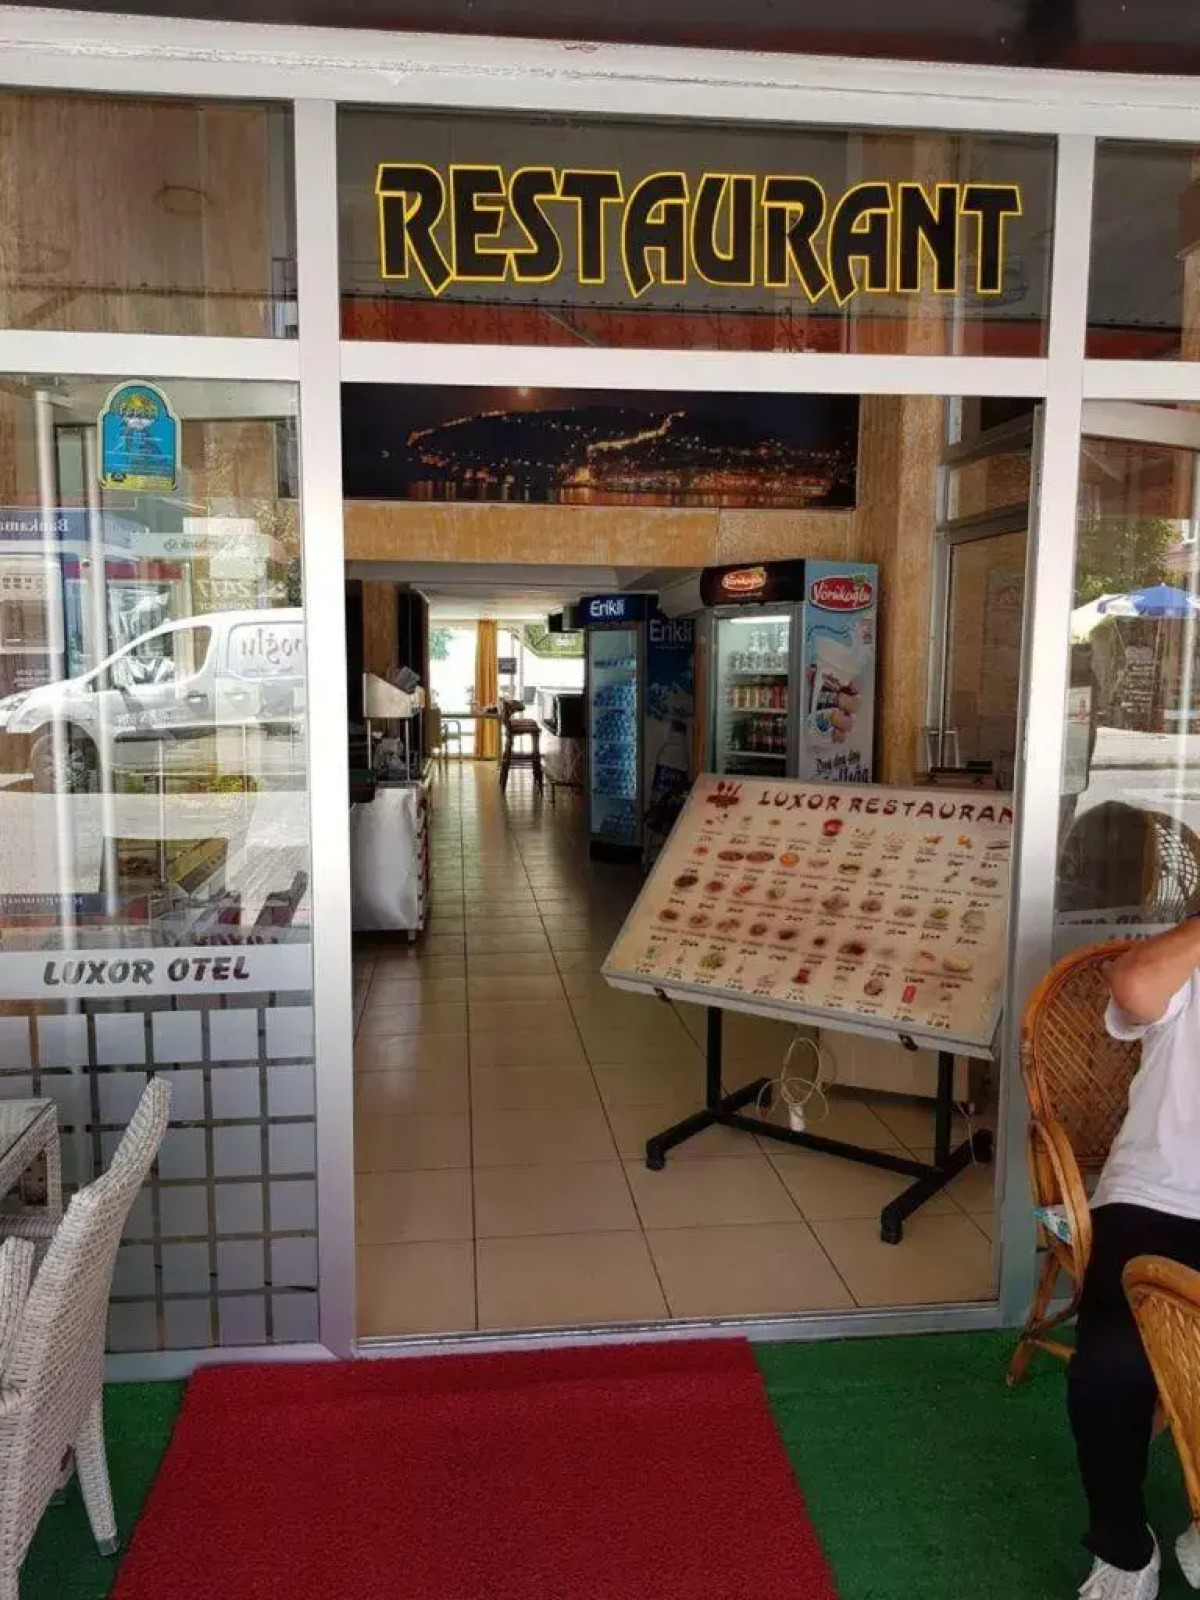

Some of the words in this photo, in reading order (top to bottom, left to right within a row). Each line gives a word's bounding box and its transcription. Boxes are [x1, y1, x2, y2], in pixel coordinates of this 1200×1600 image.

[375, 162, 1023, 306] RESTAURANT
[589, 599, 625, 616] Erikli
[757, 790, 841, 812] LUXOR
[43, 958, 155, 987] LUXOR
[167, 956, 250, 983] OTEL
